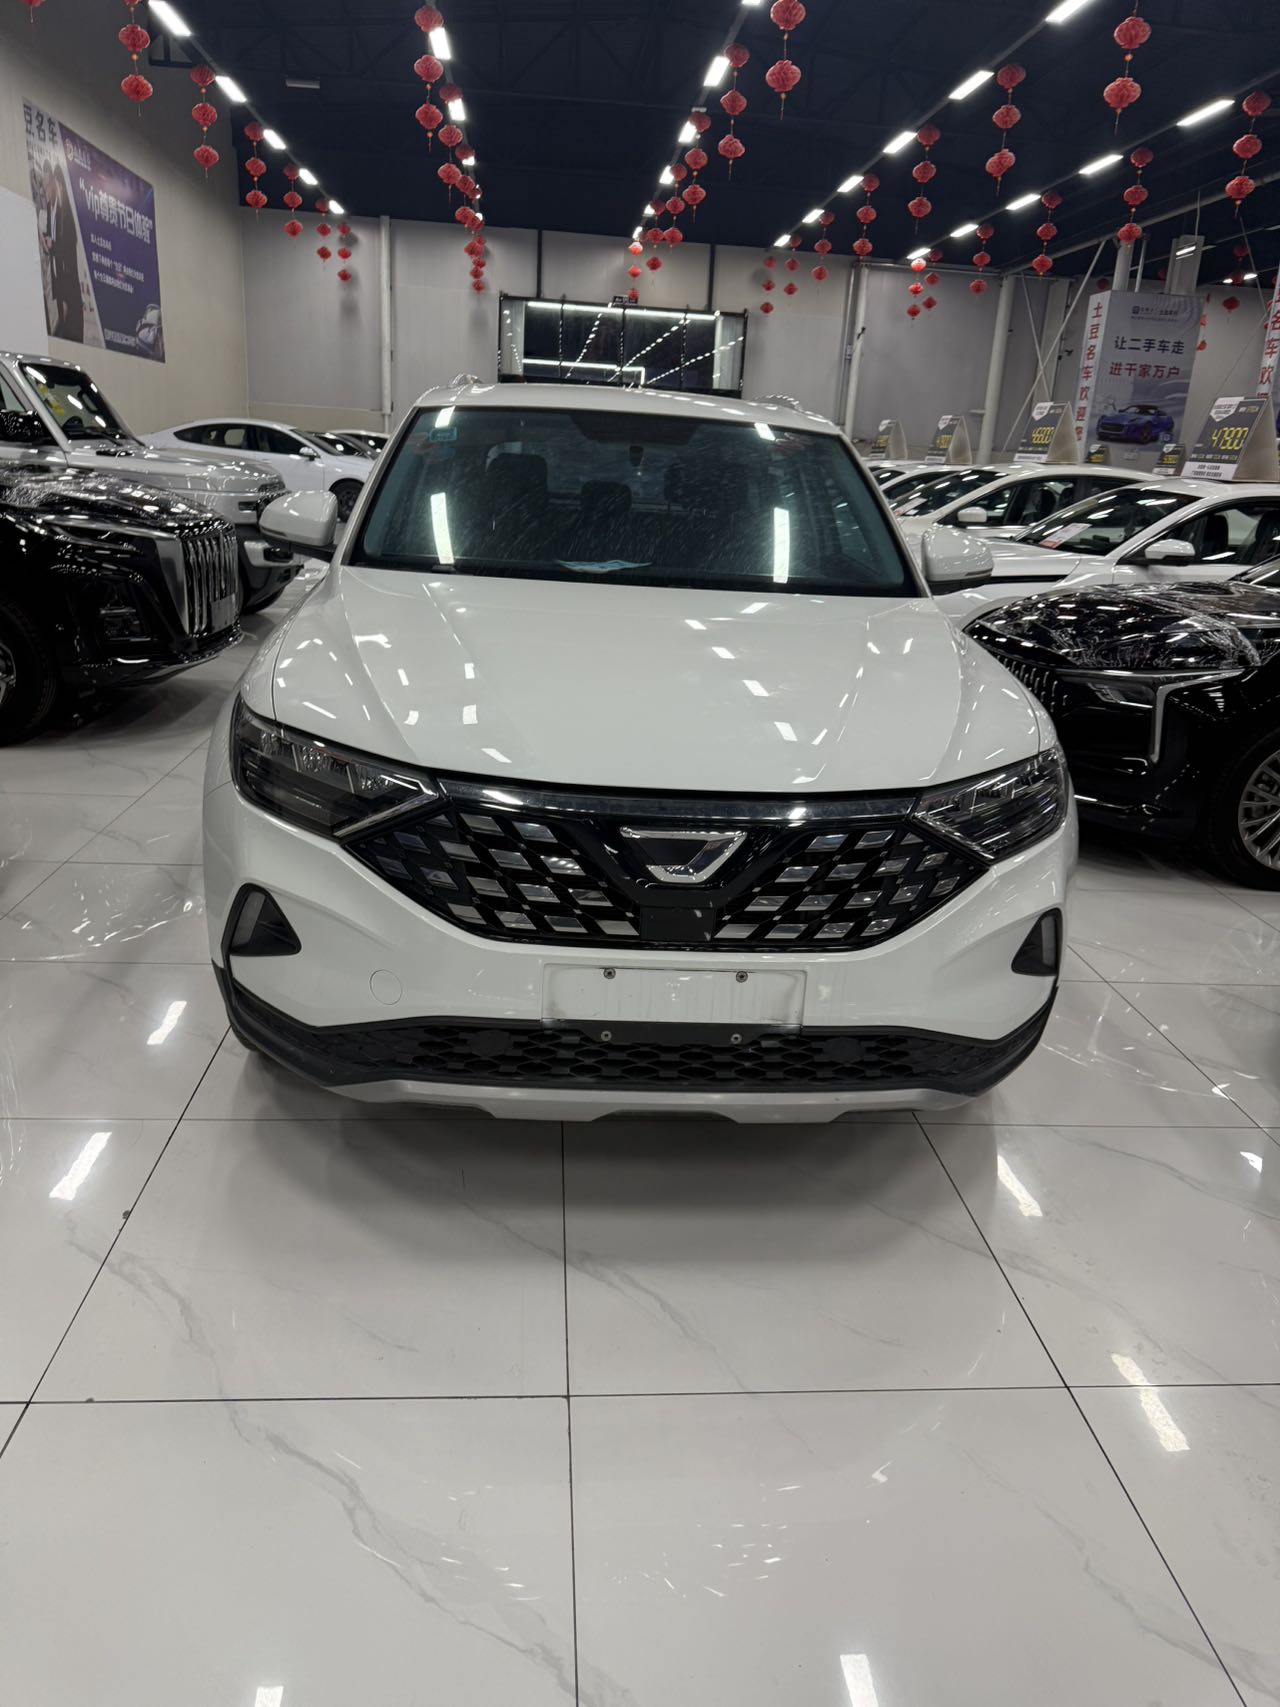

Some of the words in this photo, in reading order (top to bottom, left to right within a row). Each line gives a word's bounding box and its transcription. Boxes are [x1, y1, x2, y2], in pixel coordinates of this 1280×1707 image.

[1114, 336, 1185, 354] 让二手车走
[1109, 362, 1180, 379] 进千家万户
